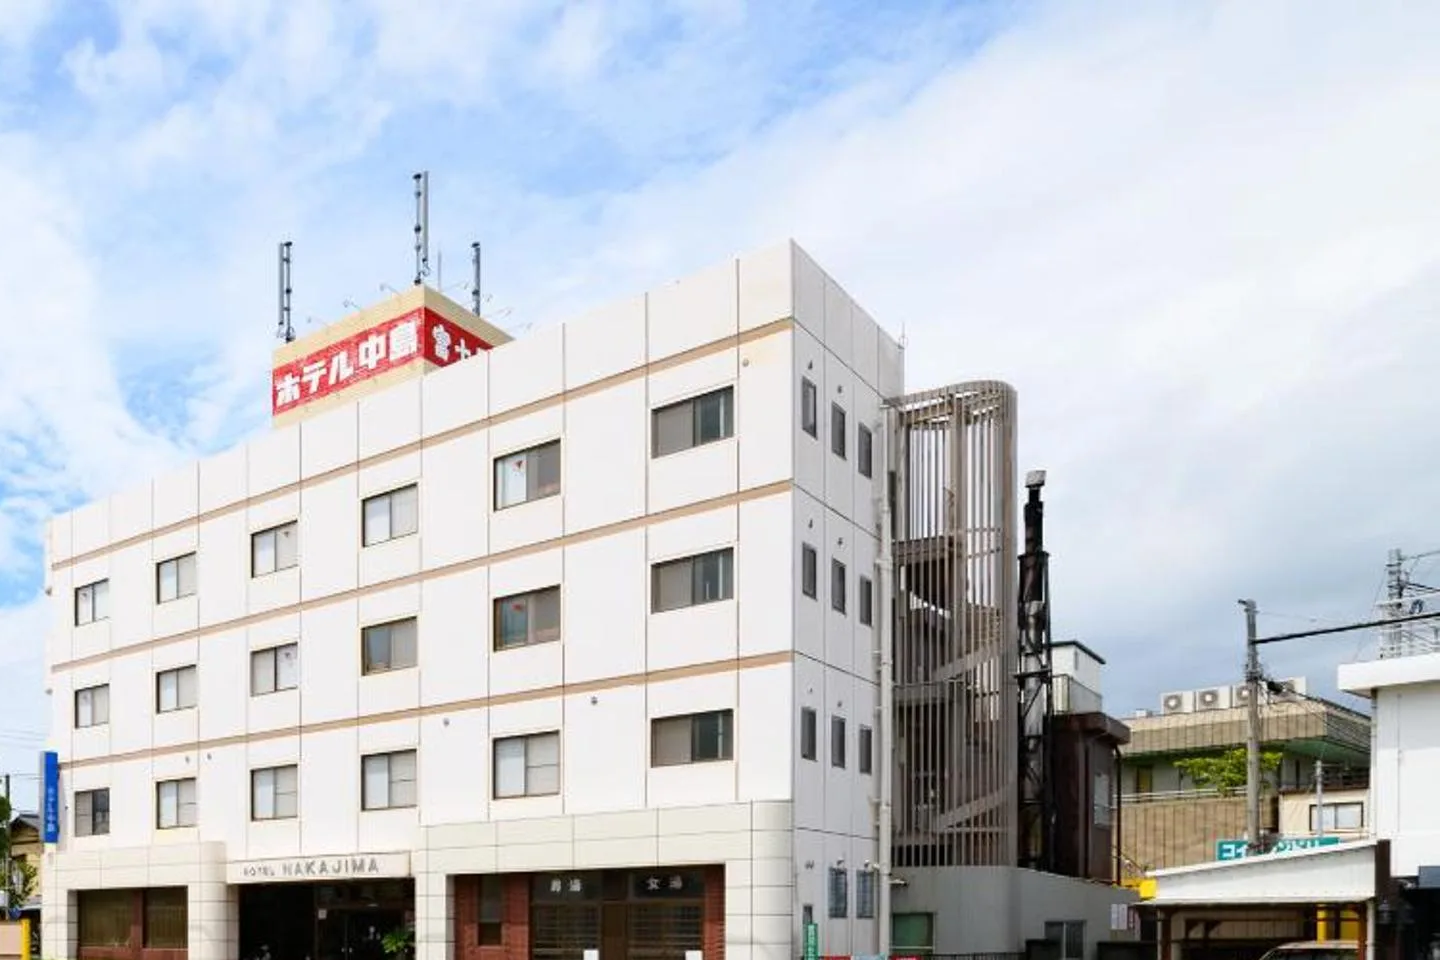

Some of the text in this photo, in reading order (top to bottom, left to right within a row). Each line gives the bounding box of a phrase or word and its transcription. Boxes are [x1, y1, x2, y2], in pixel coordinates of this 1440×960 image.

[275, 319, 419, 405] ホテル中島
[281, 856, 380, 877] NAKAJIMA
